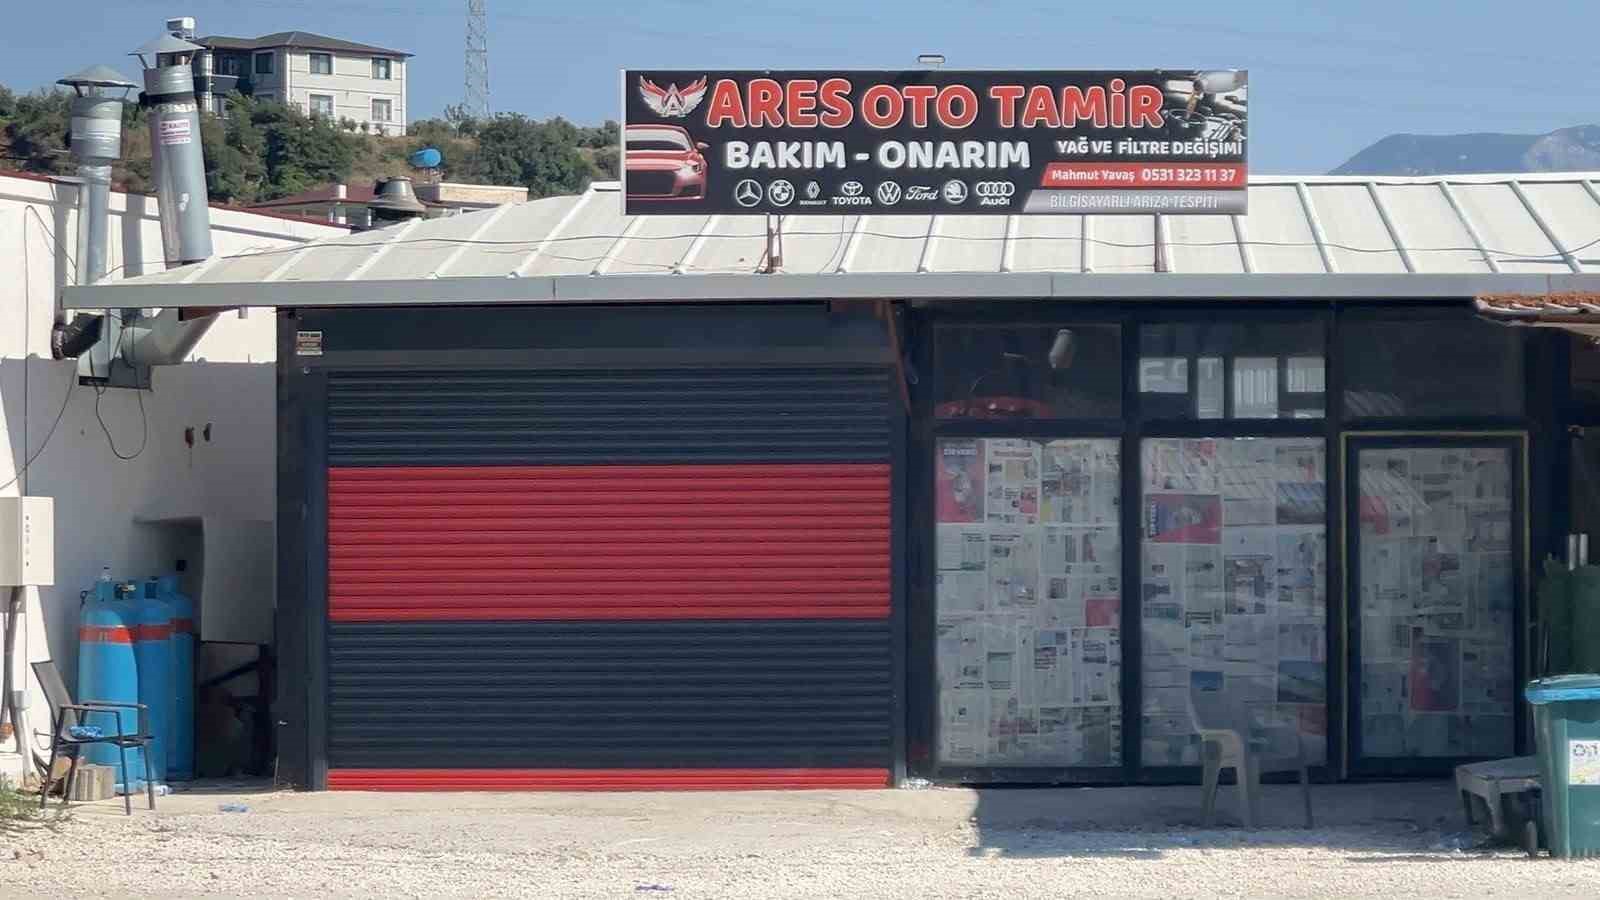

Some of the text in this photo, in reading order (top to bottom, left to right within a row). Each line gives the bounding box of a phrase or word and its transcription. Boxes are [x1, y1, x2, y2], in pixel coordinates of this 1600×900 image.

[707, 79, 853, 128] ARES
[862, 85, 978, 129] OTO
[726, 141, 846, 169] BAKIM
[878, 141, 1030, 169] ONARIM
[1057, 136, 1242, 158] YAĞ VE FİLTRE DEĞİŞİMİ
[1051, 168, 1236, 183] Mahmut Yavaş 0531 323 11 37
[832, 196, 872, 205] TOYOTA
[980, 197, 1010, 205] Audi
[905, 185, 939, 200] Ford
